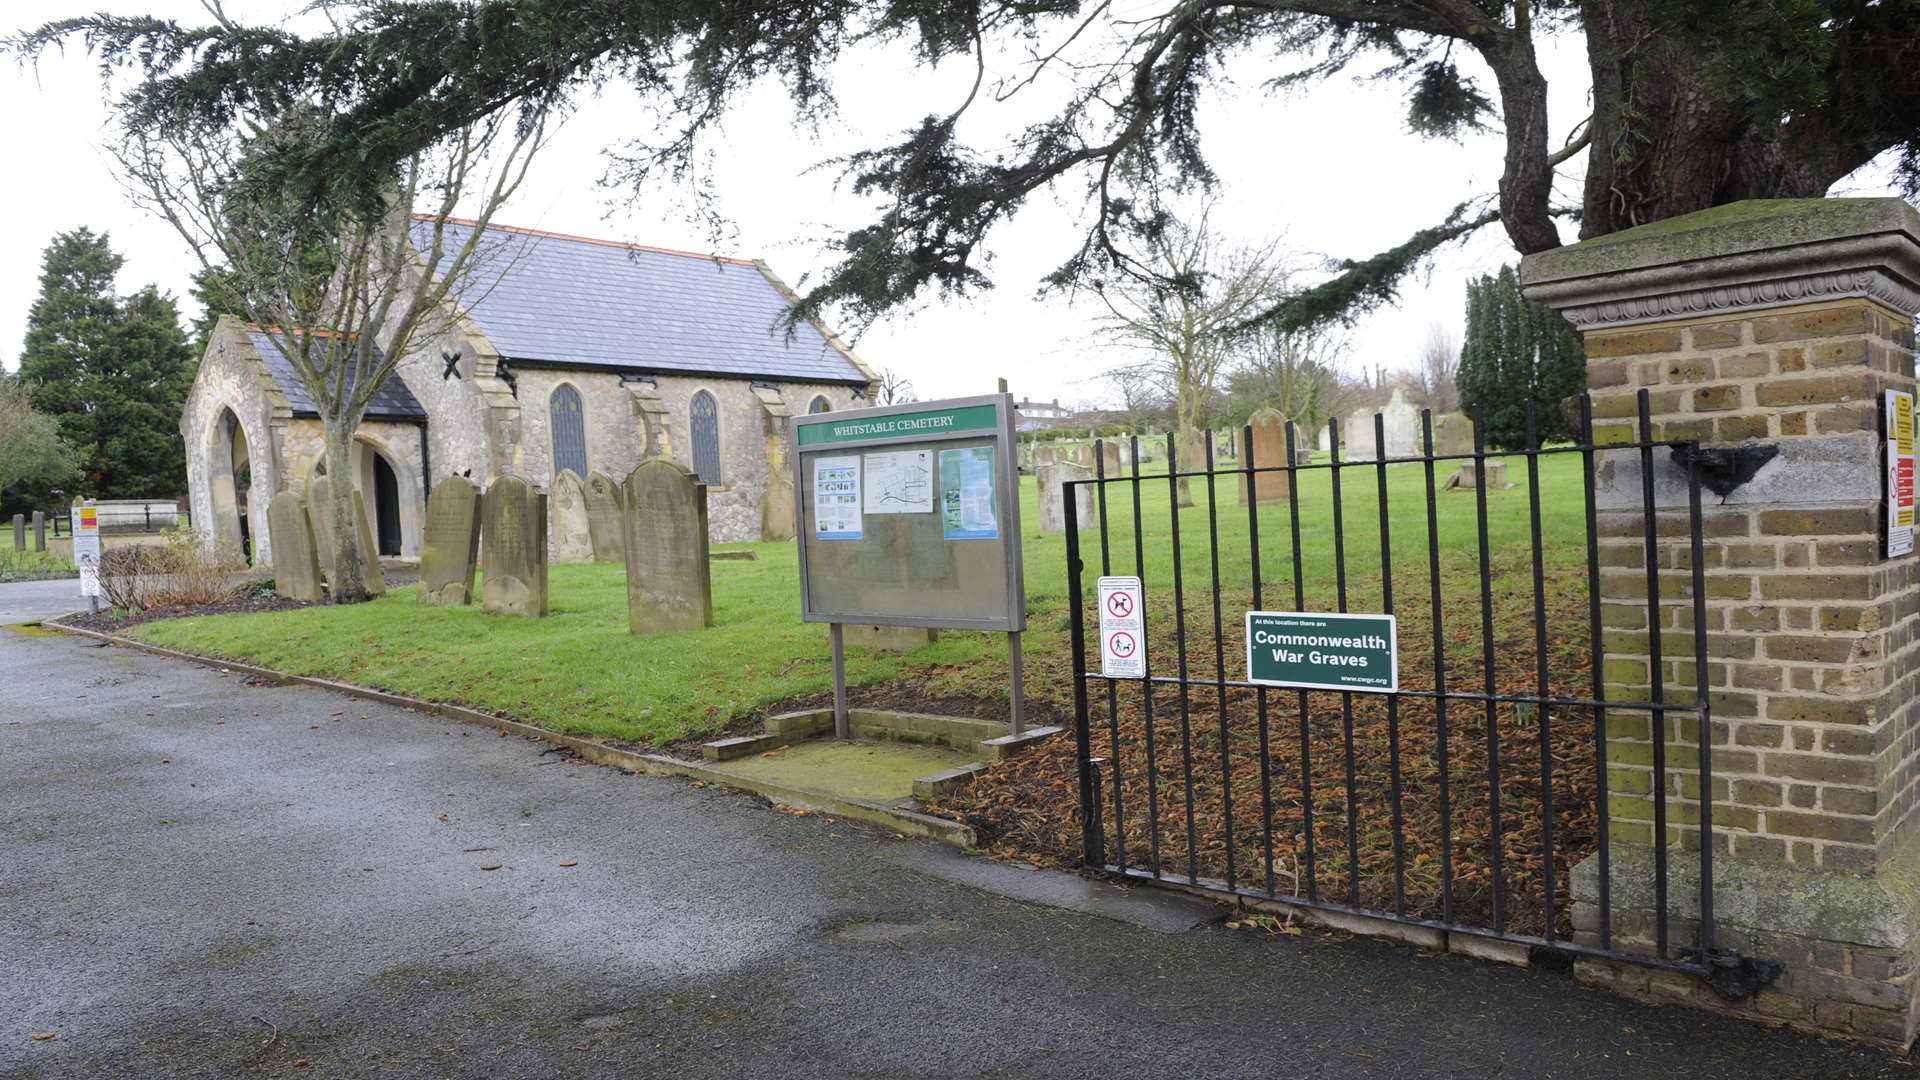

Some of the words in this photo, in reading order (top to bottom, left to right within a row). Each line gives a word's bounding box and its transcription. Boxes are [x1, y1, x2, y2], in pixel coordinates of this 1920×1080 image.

[834, 421, 896, 437] WHITSTABLE
[897, 415, 955, 431] CEMETERY
[1274, 619, 1299, 627] location
[1255, 630, 1387, 650] Commonwealth
[1272, 649, 1304, 664] War
[1309, 651, 1368, 667] Graves
[1341, 675, 1388, 685] www.cwgc.org
